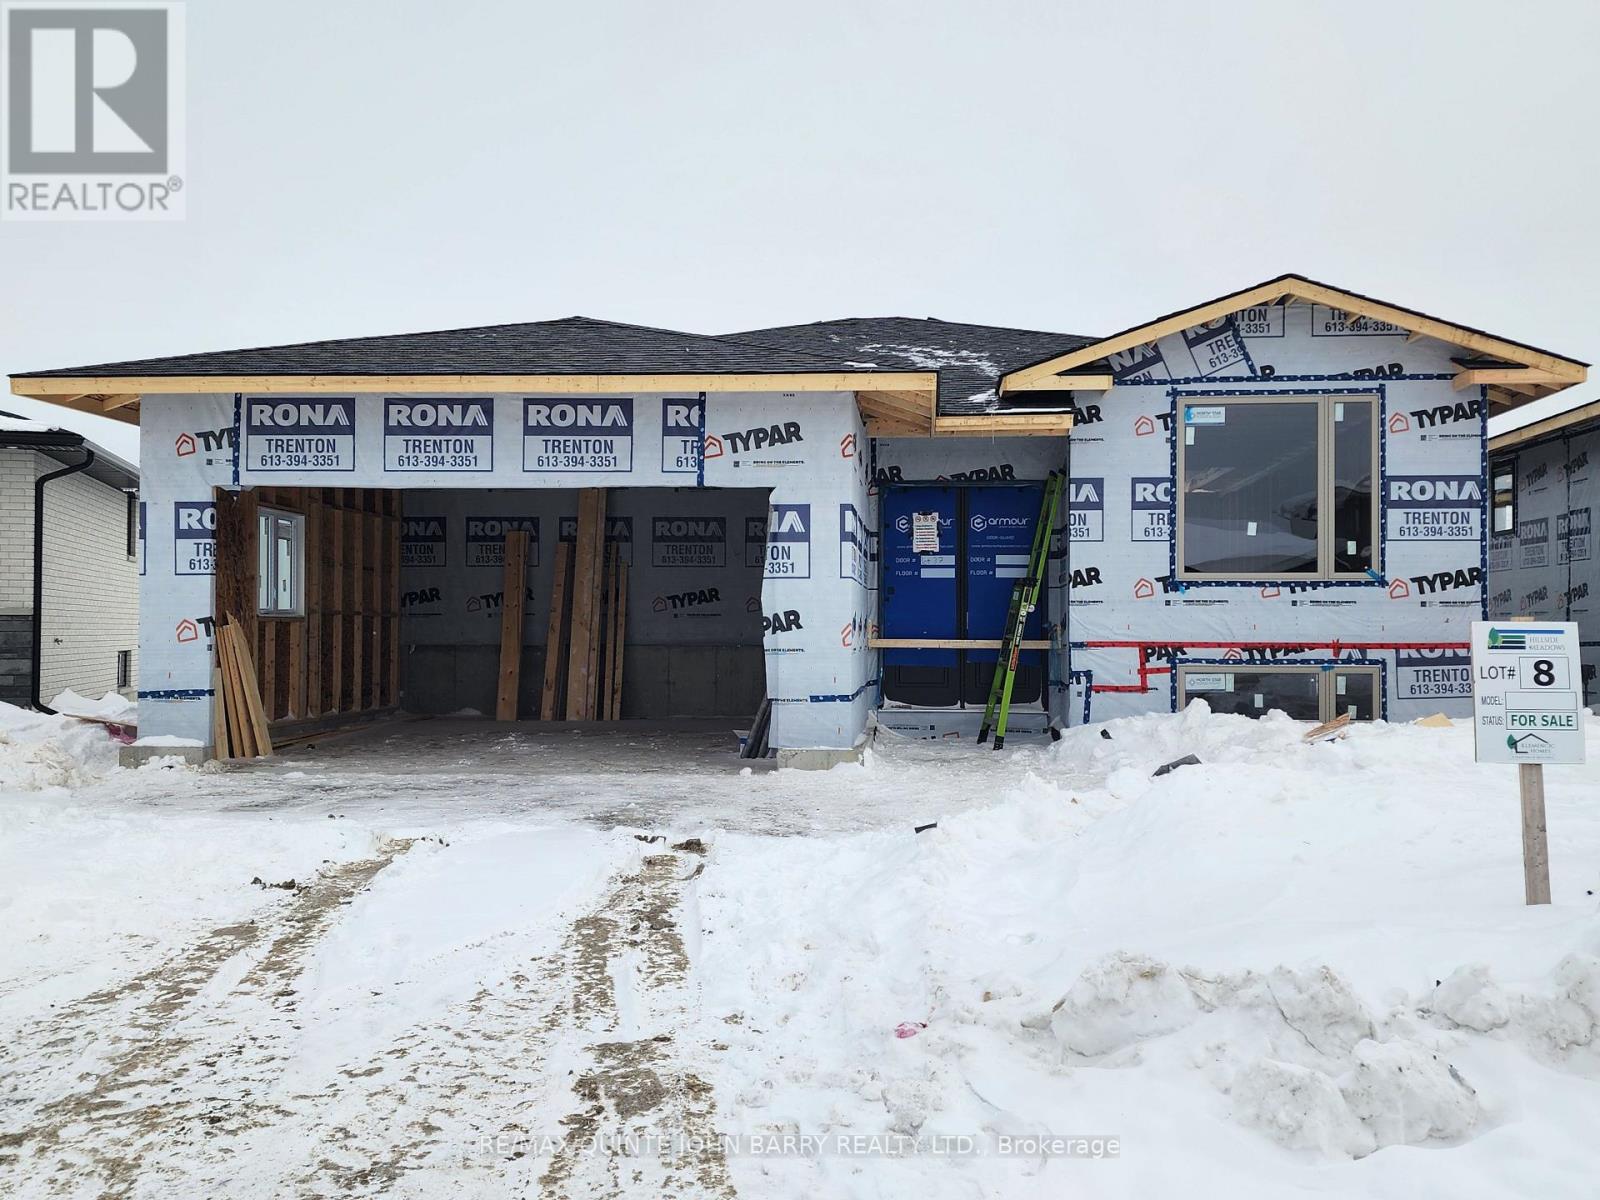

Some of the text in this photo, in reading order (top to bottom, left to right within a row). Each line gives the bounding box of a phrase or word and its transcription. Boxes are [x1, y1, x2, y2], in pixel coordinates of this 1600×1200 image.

[251, 404, 350, 426] RONA
[388, 404, 488, 426] RONA
[527, 404, 628, 427] RONA
[722, 421, 803, 454] TYPAR
[265, 438, 336, 453] TRENTON
[403, 439, 474, 454] TRENTON
[542, 439, 614, 454] TRENTON
[260, 455, 340, 466] 613-394-3351
[398, 455, 478, 467] 613-394-3351
[537, 456, 617, 468] 613-394-3351
[1135, 483, 1170, 502] RO
[1390, 480, 1481, 501] RONA
[179, 508, 216, 530] RO
[988, 517, 1029, 526] armour
[1403, 511, 1470, 525] TRENTON
[655, 521, 723, 536] RONA
[1399, 526, 1473, 537] 613-394-3351
[664, 544, 713, 555] TRENTON
[667, 587, 721, 610] TYPAR
[761, 609, 803, 637] PAR
[1413, 669, 1469, 682] TRENTO
[1480, 659, 1556, 687] LOT# 8
[1410, 683, 1472, 694] 613-394-33
[1511, 714, 1537, 727] FOR
[1541, 715, 1574, 727] SALE
